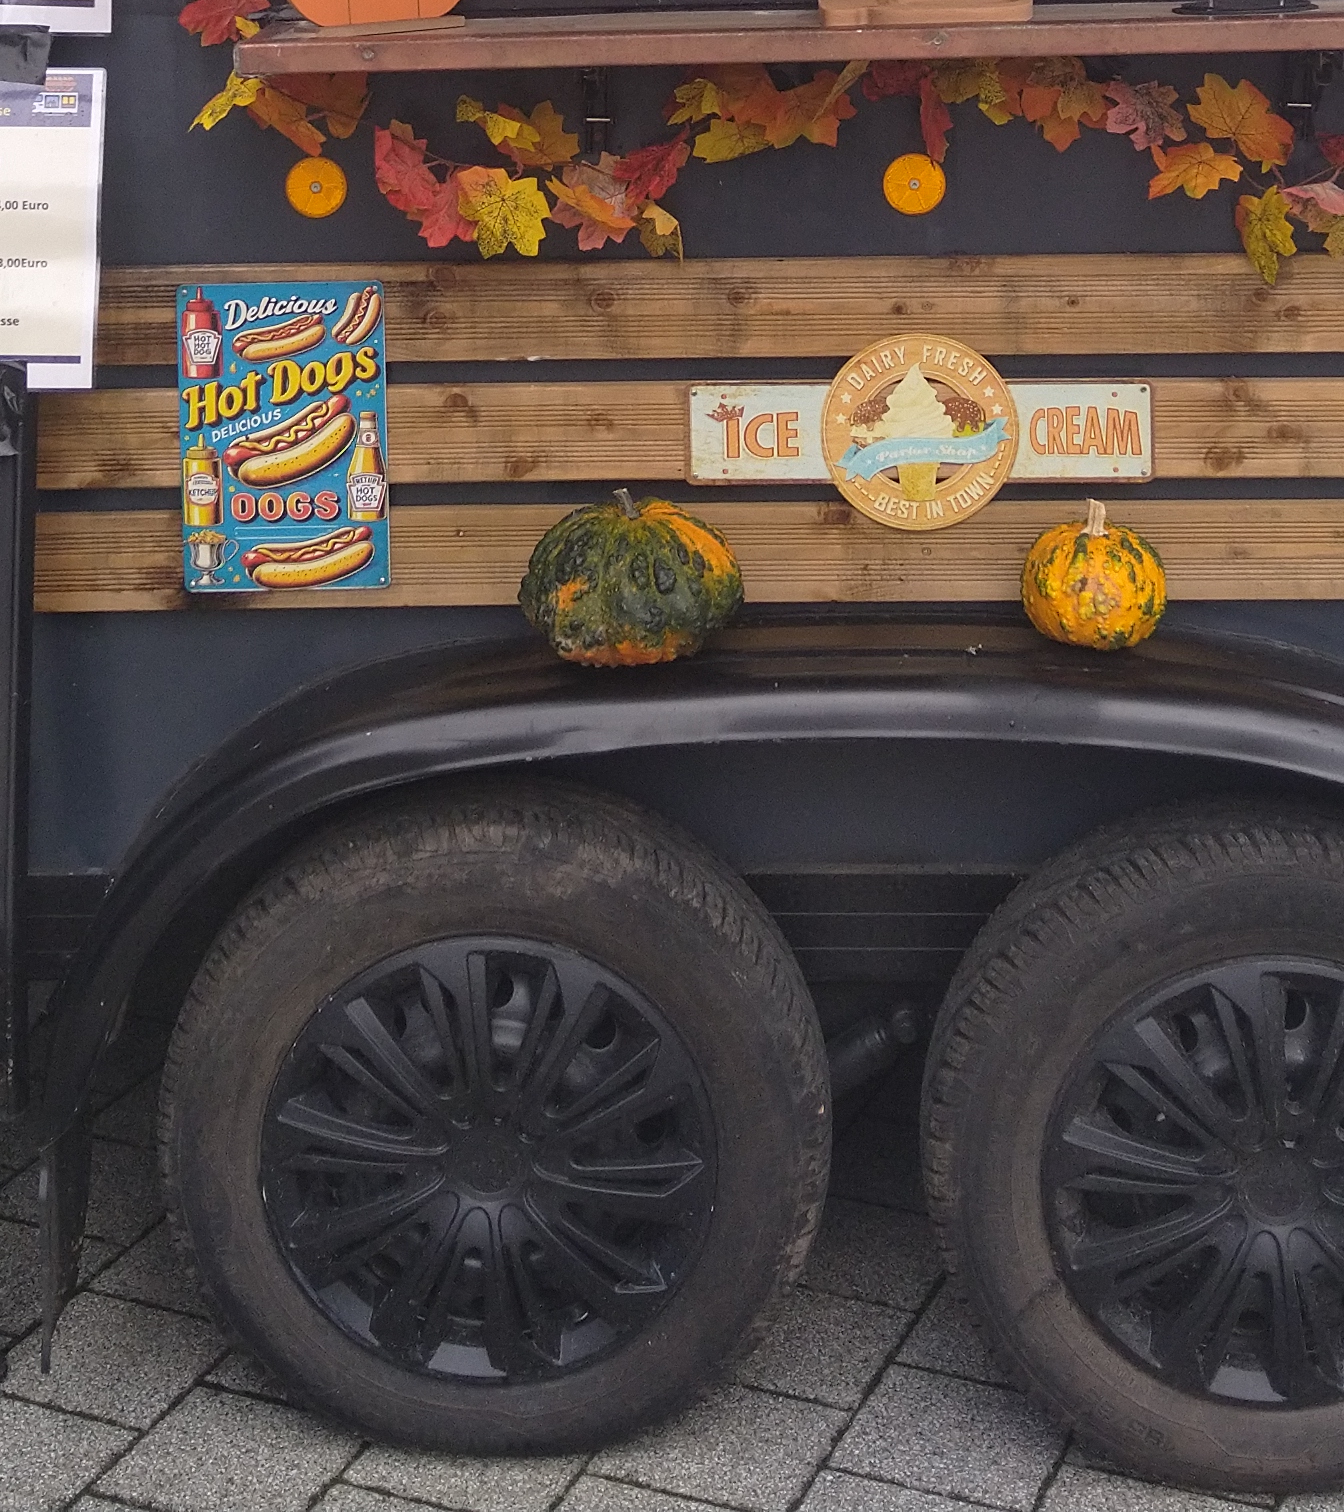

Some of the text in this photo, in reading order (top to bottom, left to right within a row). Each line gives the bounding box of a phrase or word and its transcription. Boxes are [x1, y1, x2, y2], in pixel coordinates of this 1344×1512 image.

[22, 199, 49, 212] Euro
[224, 293, 338, 331] Delicious
[182, 346, 379, 430] Hot Dogs
[845, 344, 988, 392] DAIRY FRESH
[211, 408, 283, 444] DELICIOUS
[725, 405, 1144, 460] ICE CREAM
[935, 444, 979, 461] Shop
[873, 474, 996, 521] BEST IN TOWN
